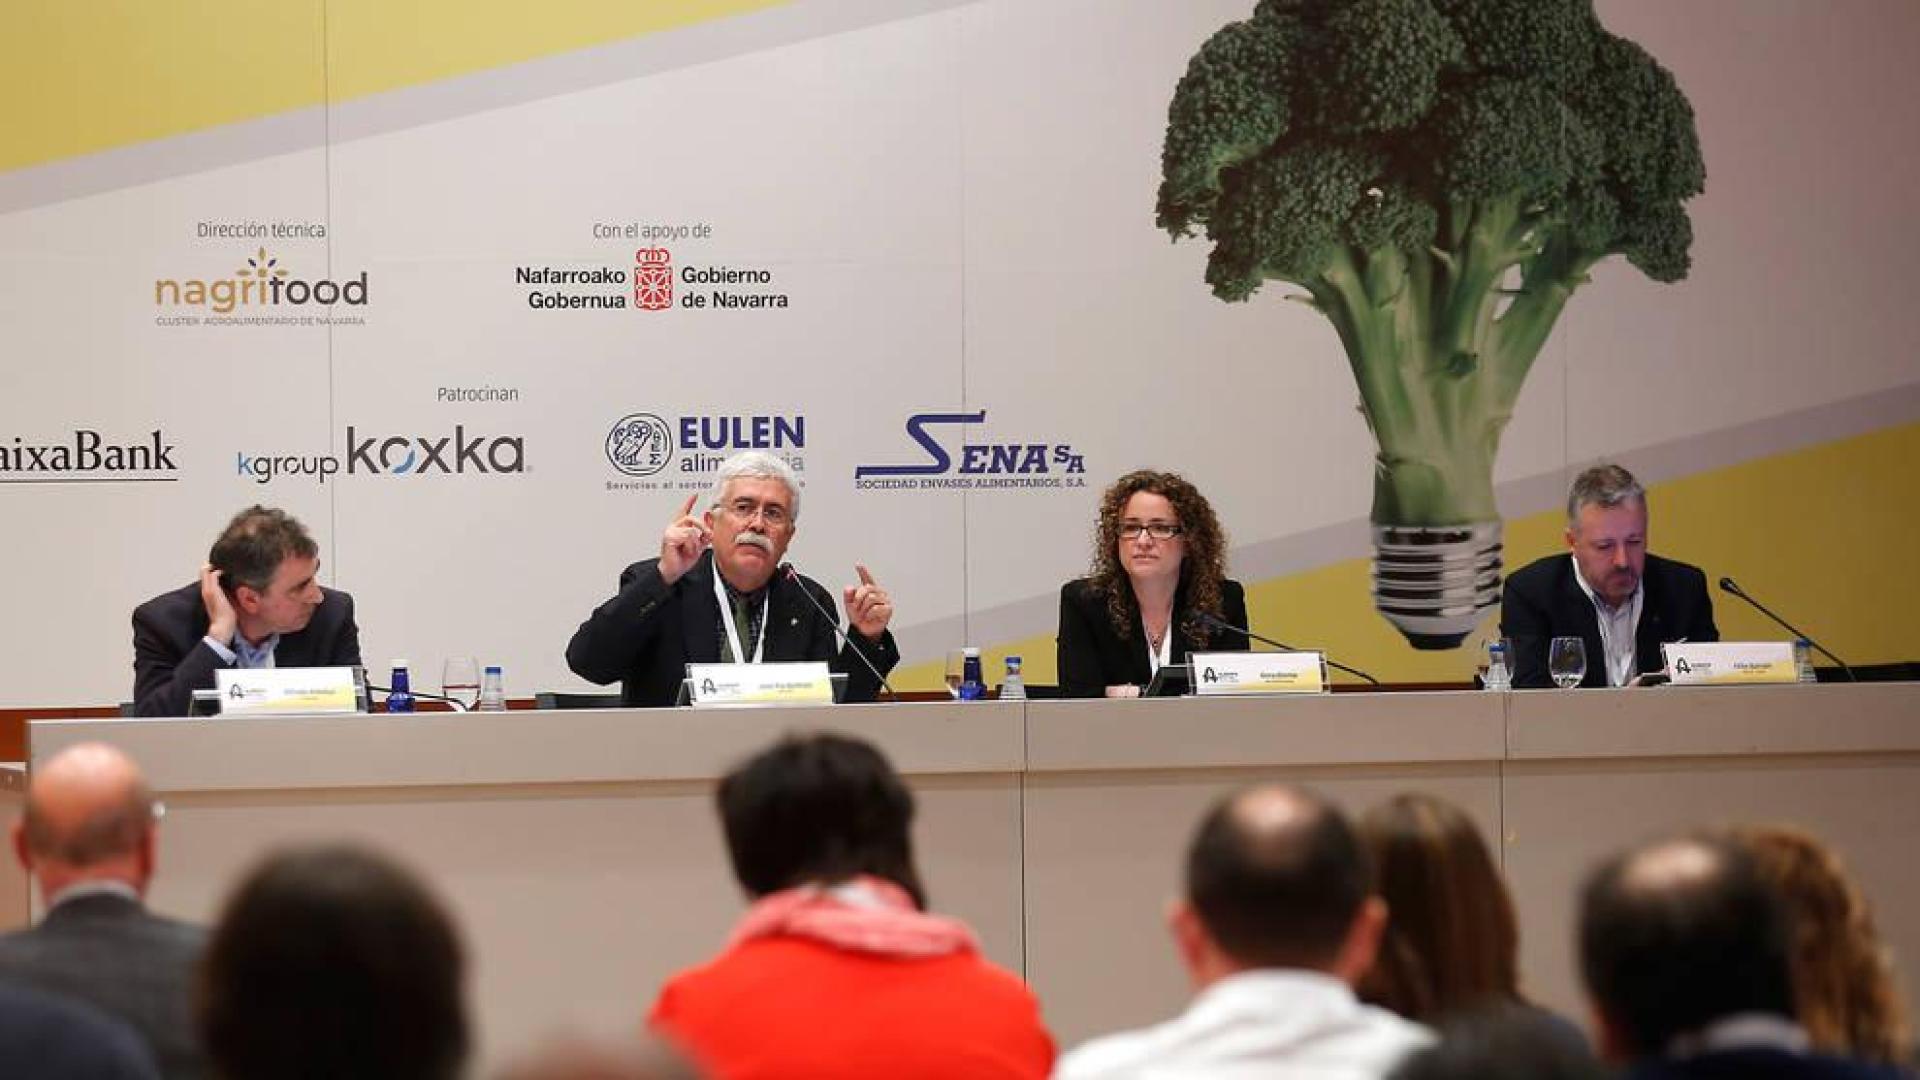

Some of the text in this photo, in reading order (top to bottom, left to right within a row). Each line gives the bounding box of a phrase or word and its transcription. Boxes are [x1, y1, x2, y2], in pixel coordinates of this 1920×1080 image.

[198, 221, 326, 238] Dirección técnica
[592, 222, 712, 241] Con el apoyo de
[515, 267, 626, 284] Nafarroako
[681, 266, 771, 284] Gobierno
[528, 291, 626, 309] Gobernua
[682, 290, 788, 309] de Navarra
[437, 386, 519, 401] Patrocinan
[680, 416, 805, 448] EULEN
[346, 424, 525, 474] koxka
[855, 409, 1049, 479] SENA
[237, 451, 339, 483] kgroup
[856, 479, 917, 489] SOCIEDAD
[920, 479, 972, 489] ENVASES
